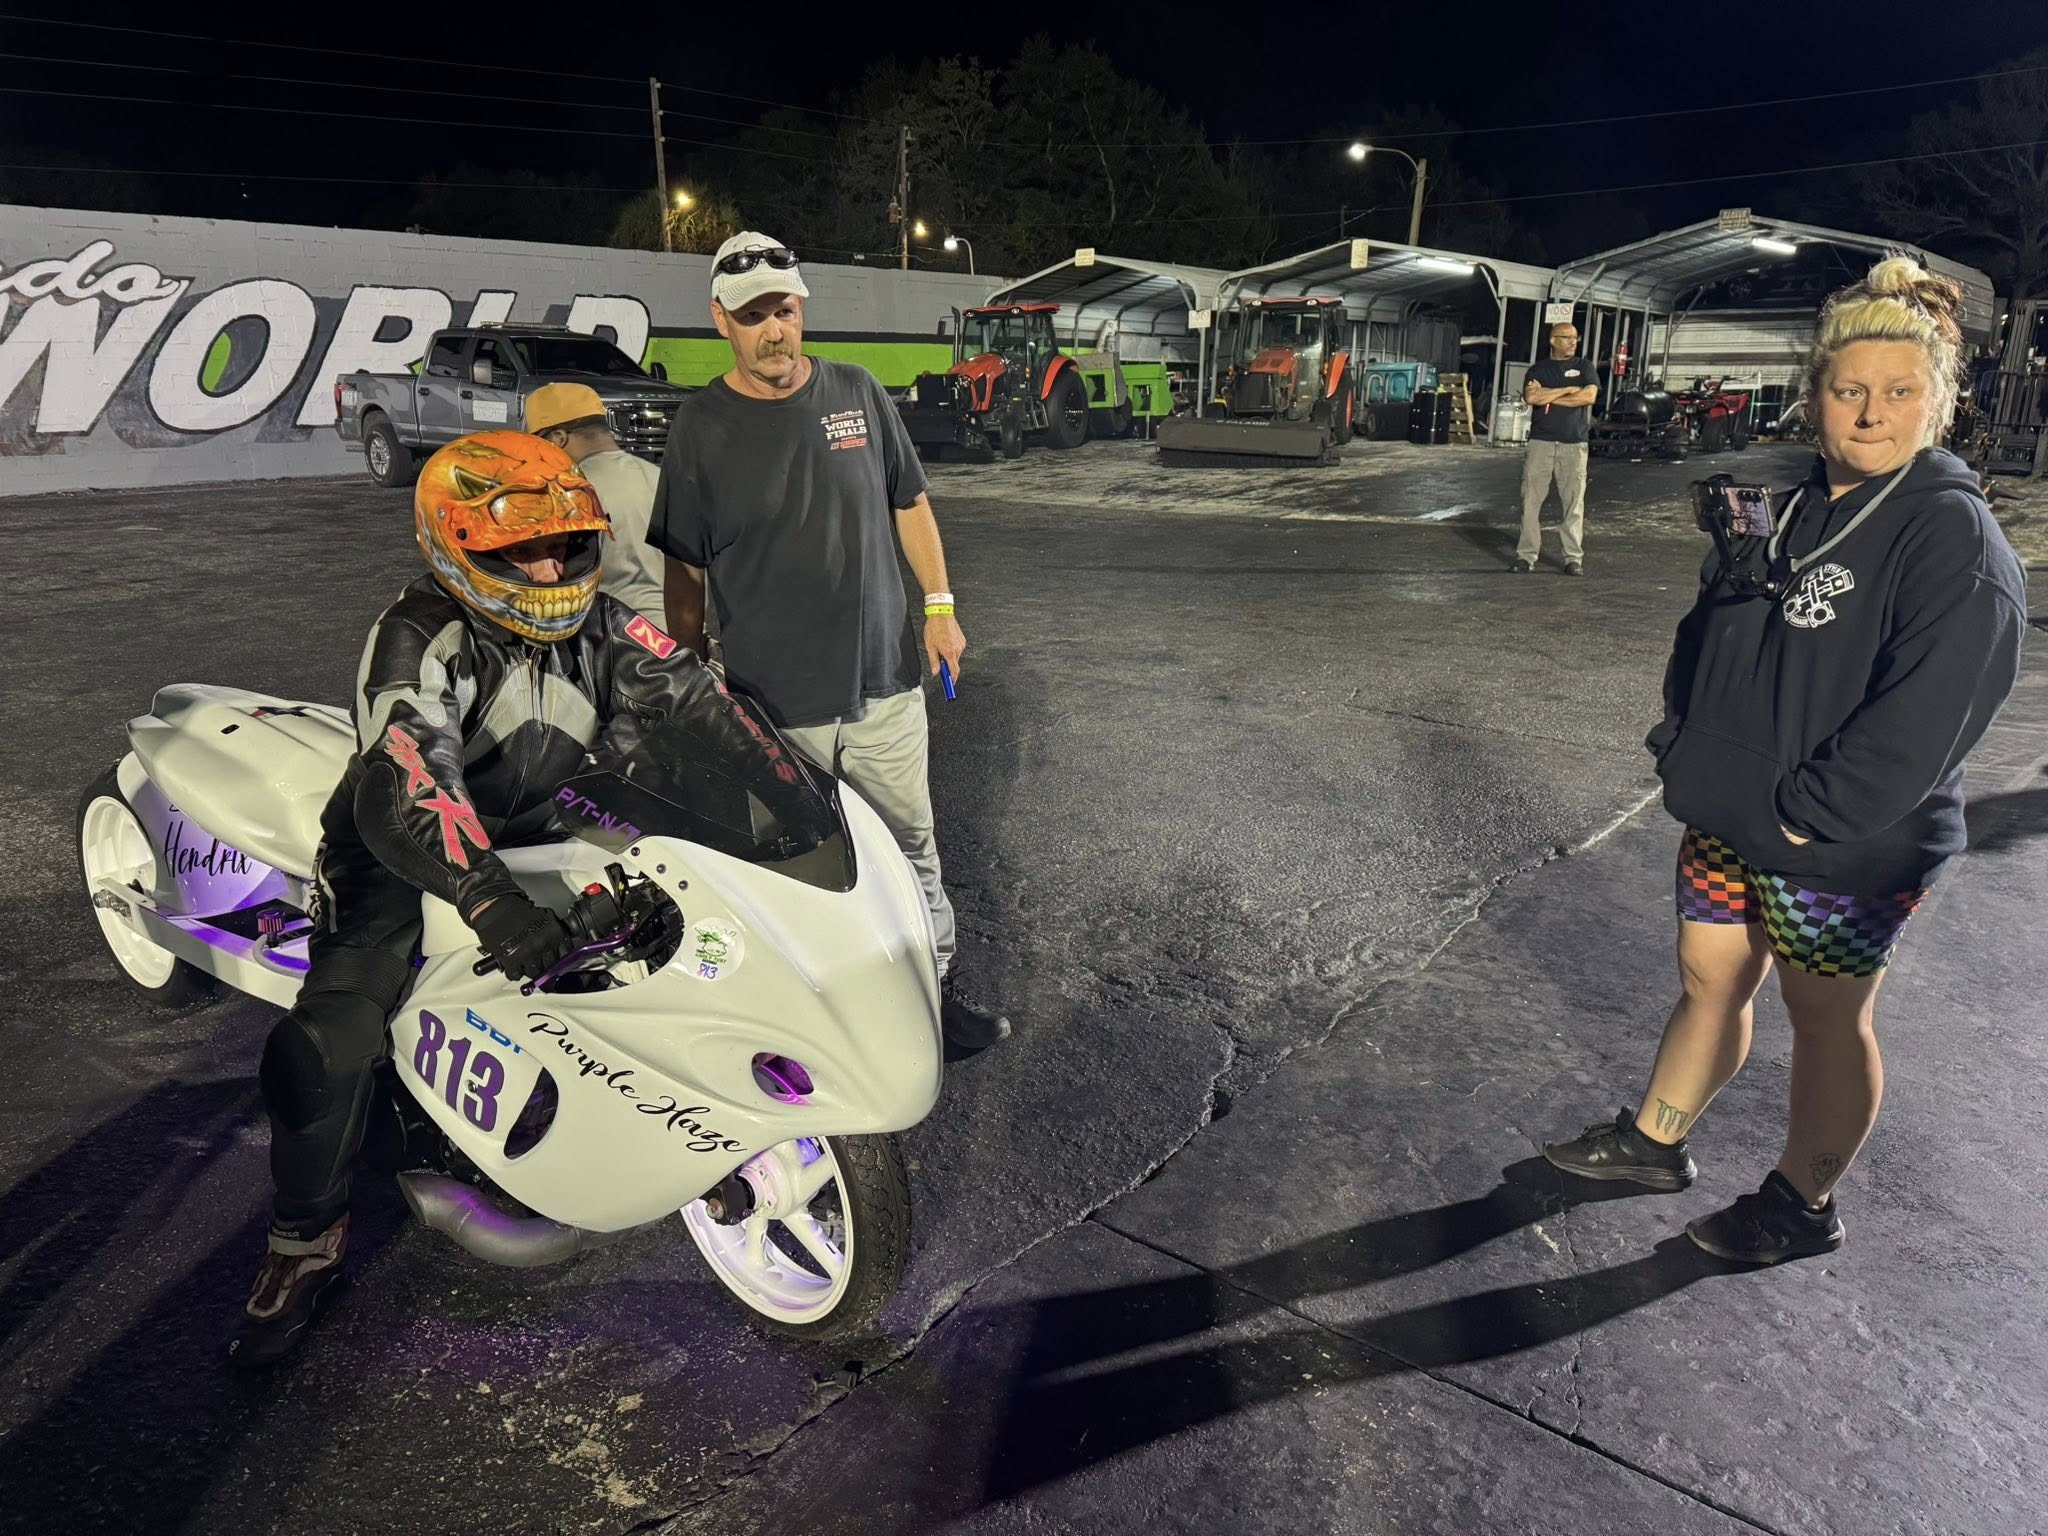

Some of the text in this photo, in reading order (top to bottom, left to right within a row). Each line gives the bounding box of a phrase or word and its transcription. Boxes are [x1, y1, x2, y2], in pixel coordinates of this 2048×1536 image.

[0, 238, 182, 304] do
[825, 418, 865, 431] WORLD
[826, 426, 867, 440] FINALS
[413, 1008, 505, 1133] 813
[527, 1012, 748, 1153] Purple Haze
